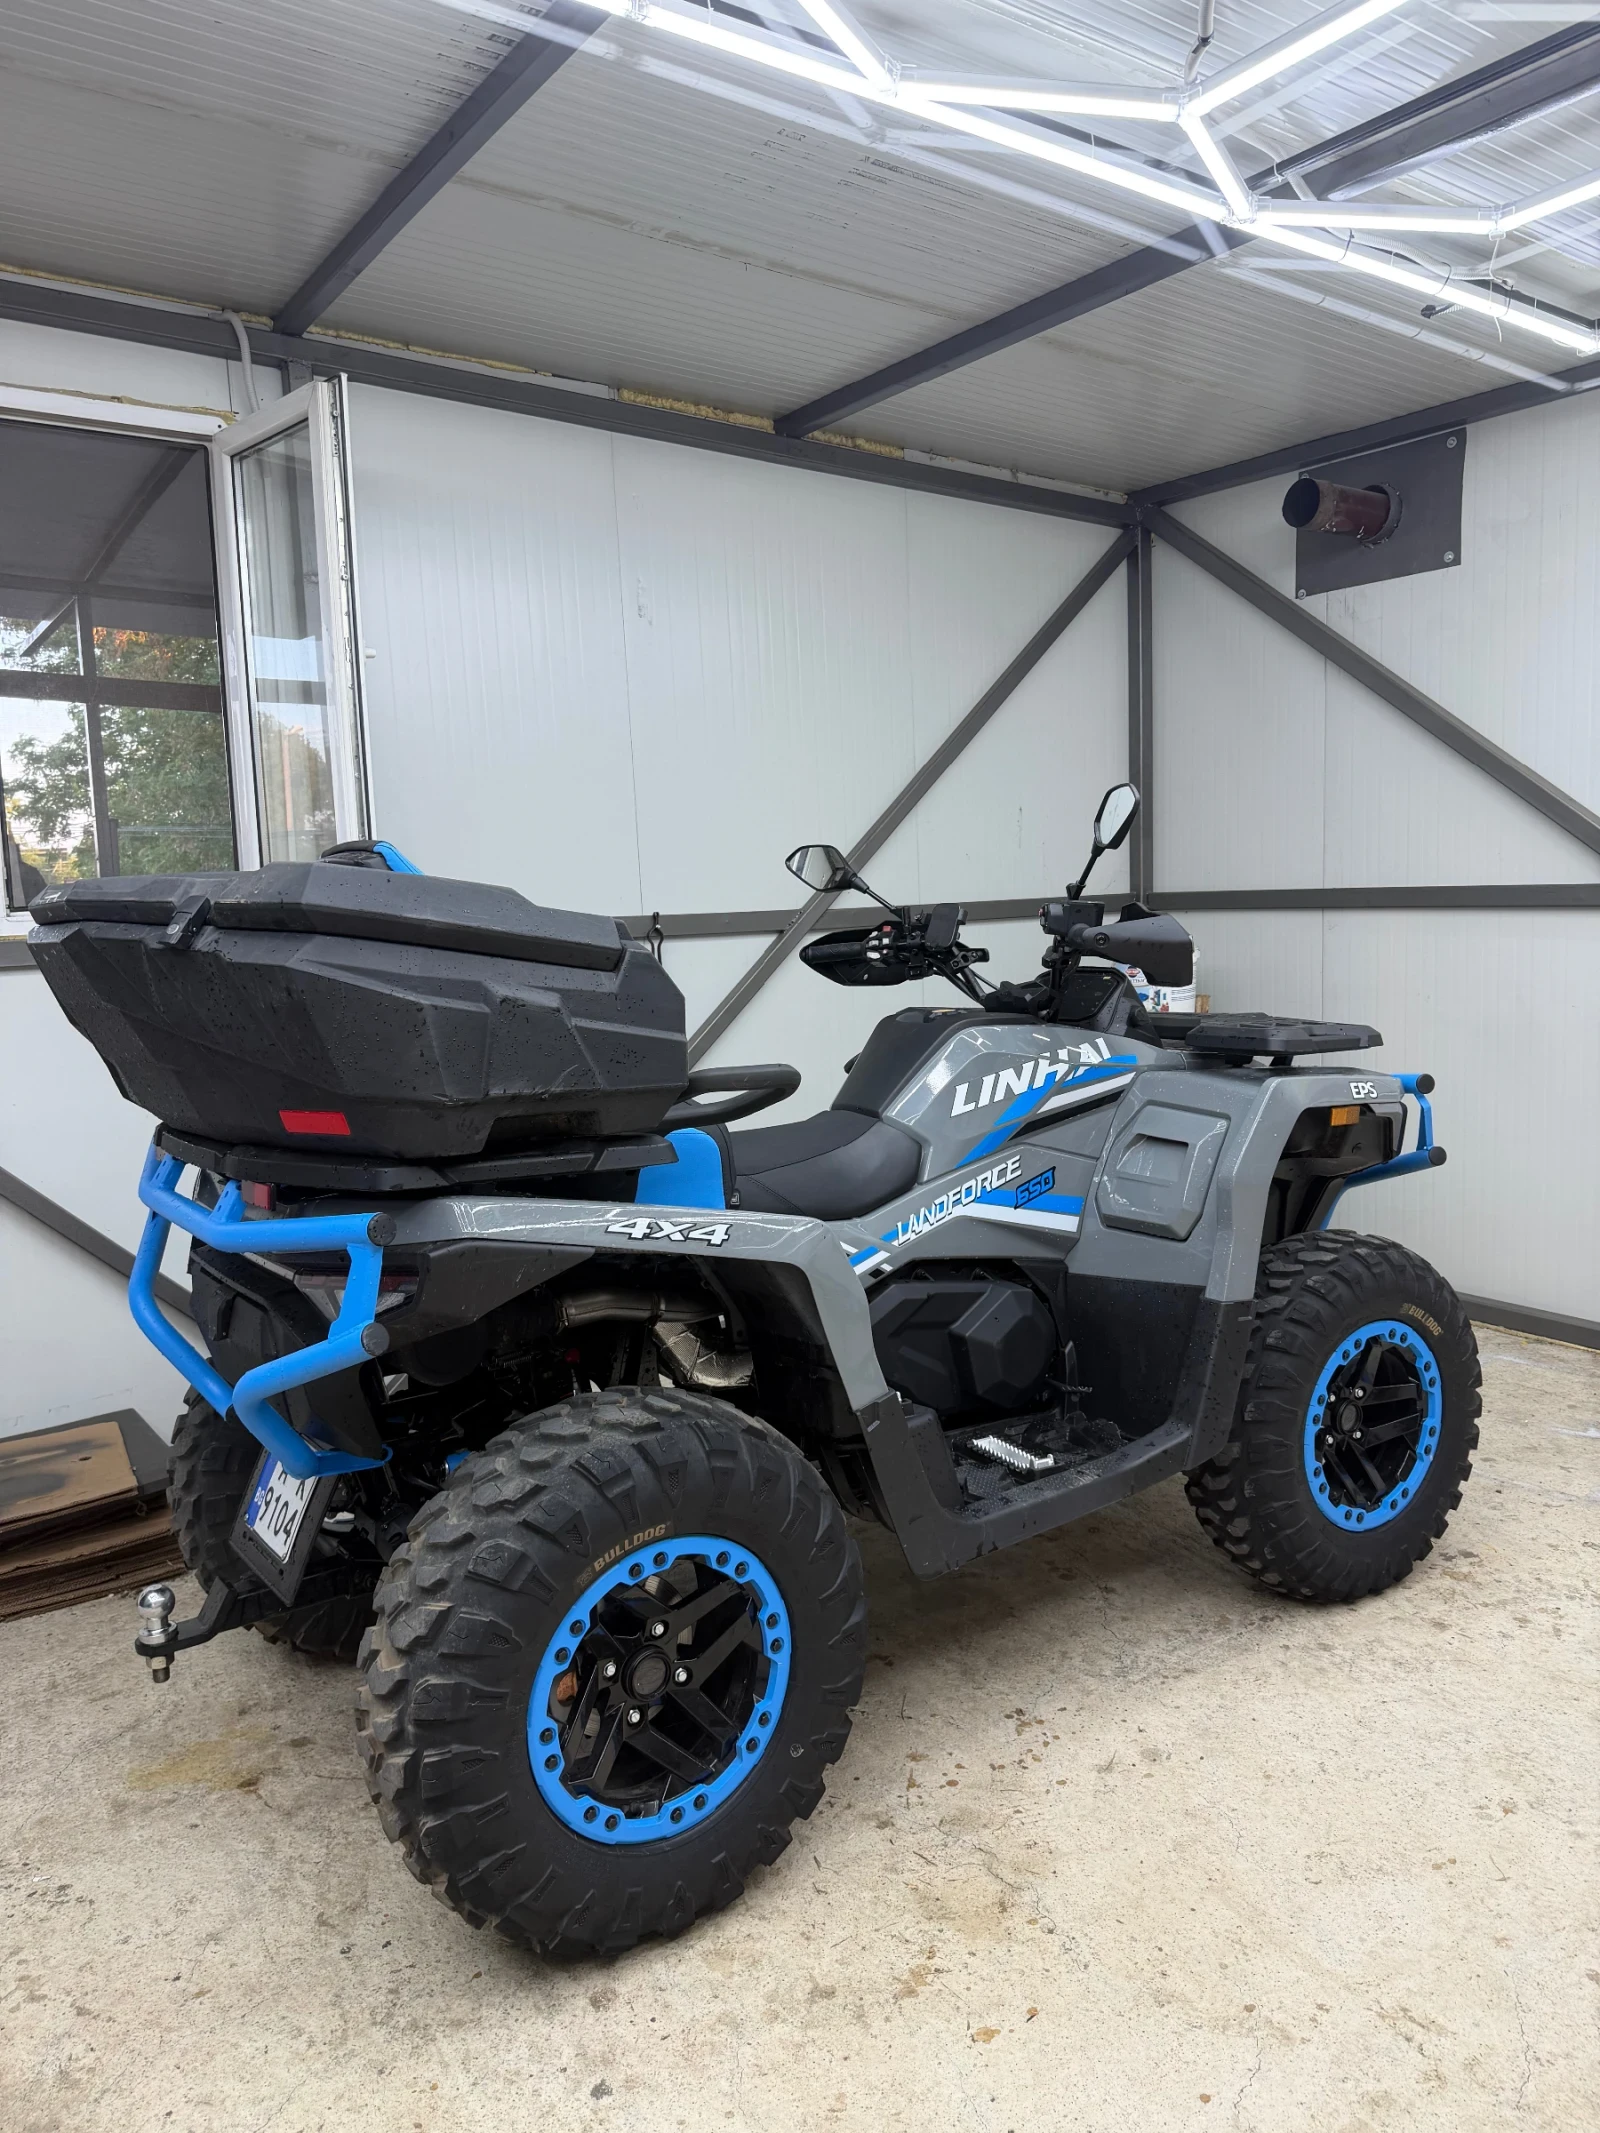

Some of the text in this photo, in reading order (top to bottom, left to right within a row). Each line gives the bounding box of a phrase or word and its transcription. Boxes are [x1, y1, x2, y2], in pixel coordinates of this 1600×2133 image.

[950, 1037, 1112, 1118] LINHAI
[1349, 1081, 1378, 1099] EPS
[896, 1154, 1056, 1247] LANDFORCE 650
[1408, 1305, 1442, 1336] BULLDOG
[259, 1486, 299, 1546] 9104
[593, 1523, 667, 1573] BULLDOG
